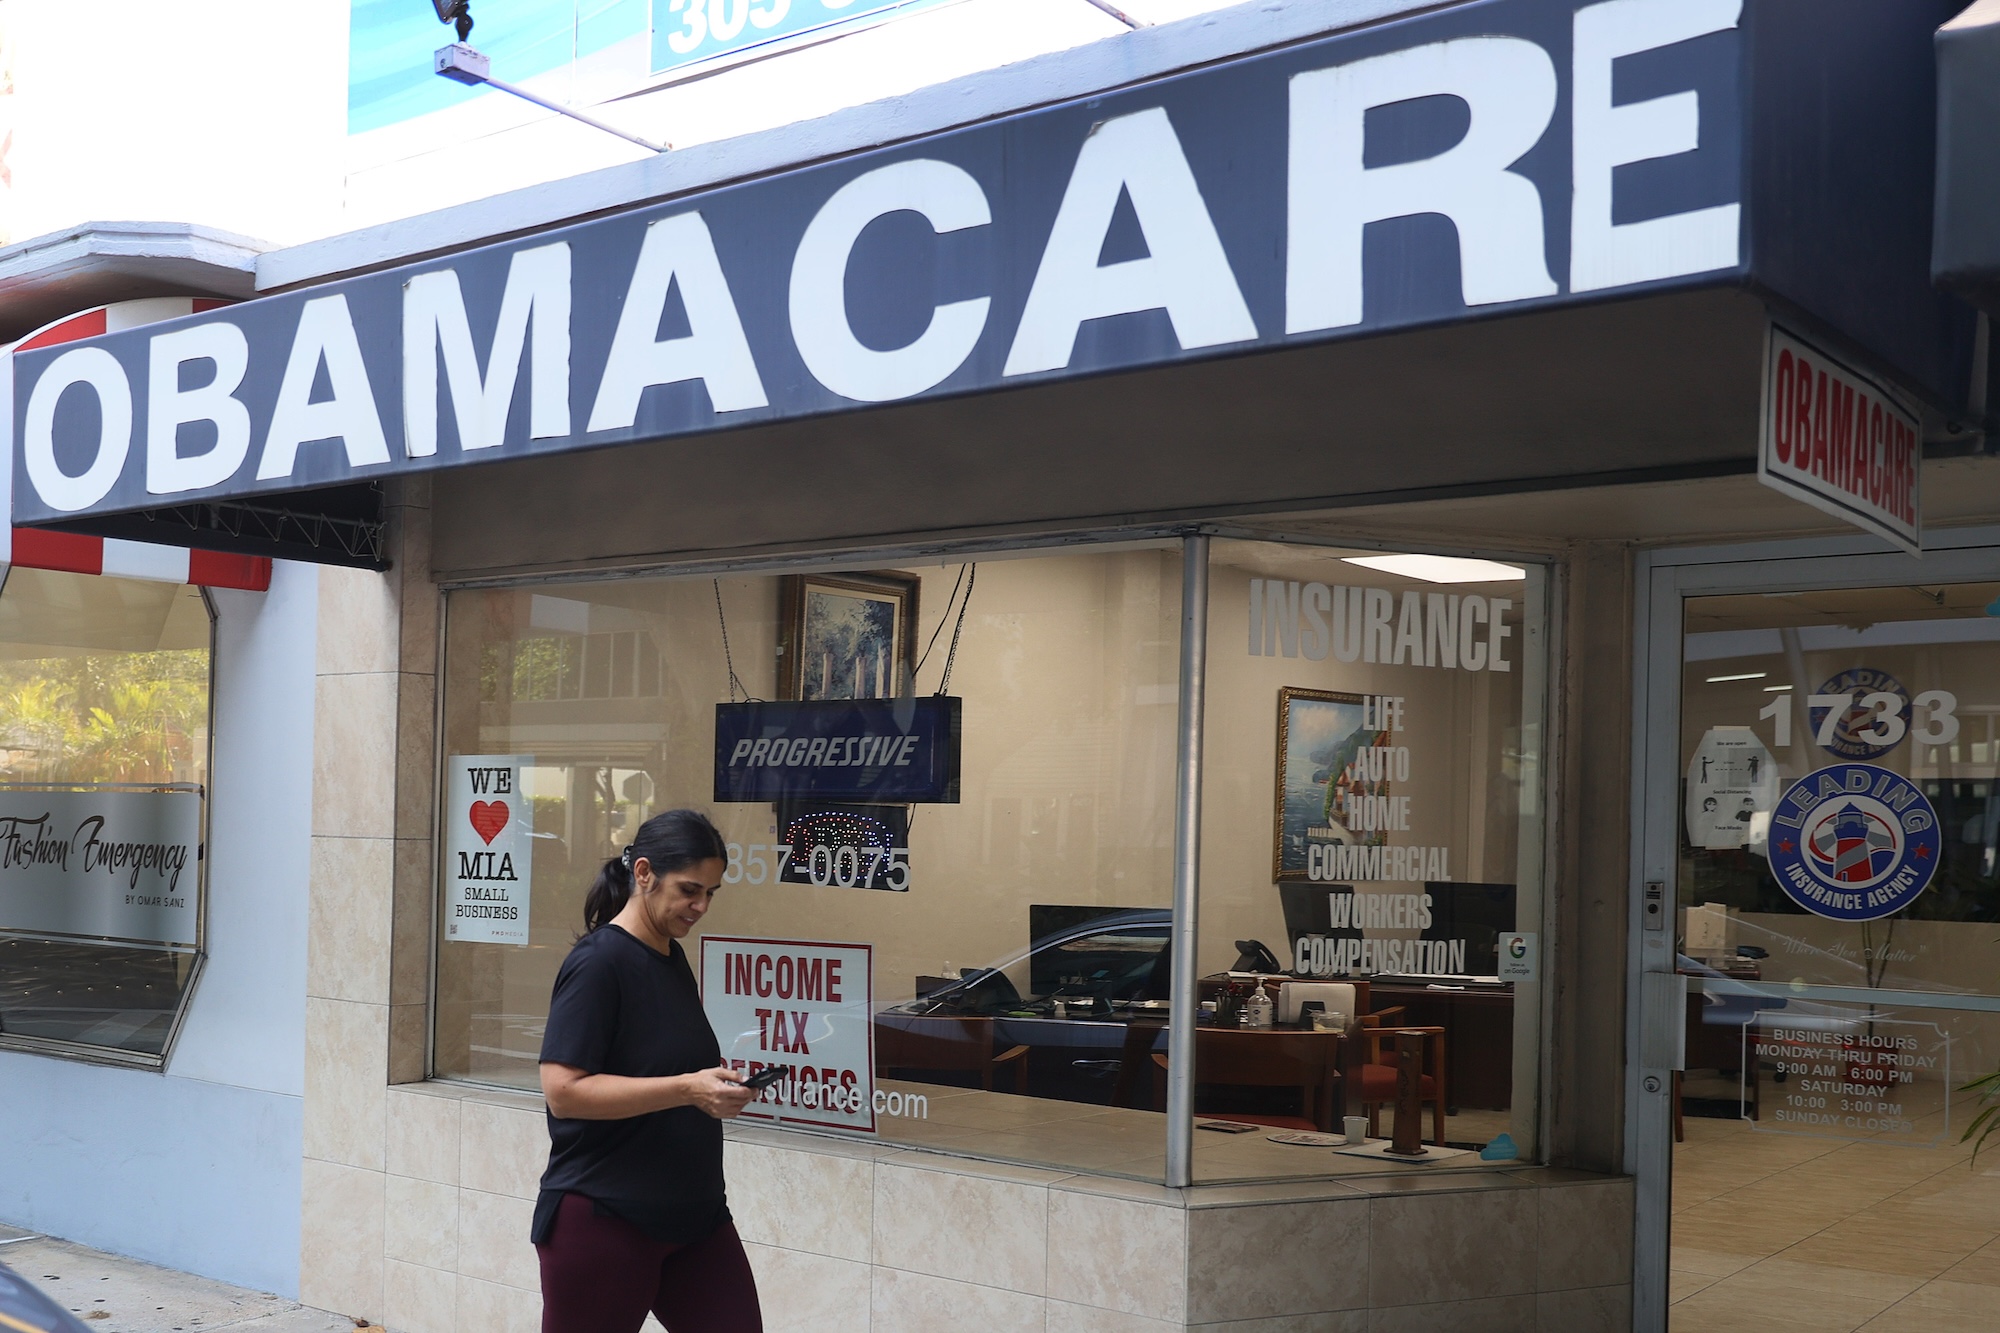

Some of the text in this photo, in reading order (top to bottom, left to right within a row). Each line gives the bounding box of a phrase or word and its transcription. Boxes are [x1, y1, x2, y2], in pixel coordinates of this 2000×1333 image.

[24, 0, 1743, 513] OBAMACARE
[1774, 348, 1915, 528] OBAMACARE
[1247, 578, 1512, 673] INSURANCE
[1362, 695, 1405, 732] LIFE
[1759, 690, 1960, 747] 1733
[728, 735, 921, 768] PROGRESSIVE
[1354, 746, 1410, 782] AUTO
[467, 767, 512, 794] WE
[1347, 796, 1411, 832] HOME
[1775, 769, 1933, 835] LEADING
[0, 811, 188, 892] Fashion Emergency
[457, 851, 519, 882] MIA
[722, 842, 911, 891] 857-0075
[1307, 844, 1452, 882] COMMERCIAL
[125, 894, 185, 908] BY OMAR SANZ
[464, 887, 509, 902] SMALL
[1784, 862, 1920, 910] INSURANCE AGENCY
[455, 904, 518, 920] BUSINESS
[1329, 892, 1433, 930] WORKERS
[1295, 937, 1466, 976] COMPENSATION
[1512, 968, 1530, 976] Google
[724, 952, 843, 1003] INCOME
[755, 1008, 810, 1055] TAX
[1773, 1028, 1918, 1050] BUSINESS HOURS
[1755, 1043, 1937, 1068] MONDAY THRU FRIDAY
[1776, 1062, 1808, 1075] 9:00
[1812, 1065, 1837, 1077] AM
[1851, 1067, 1884, 1081] 6:00
[1889, 1071, 1913, 1084] PM
[1786, 1095, 1902, 1115] 10:00 3:00 PM
[1801, 1079, 1888, 1098] SATURDAY
[1775, 1109, 1913, 1134] SUNDAY CLOSED
